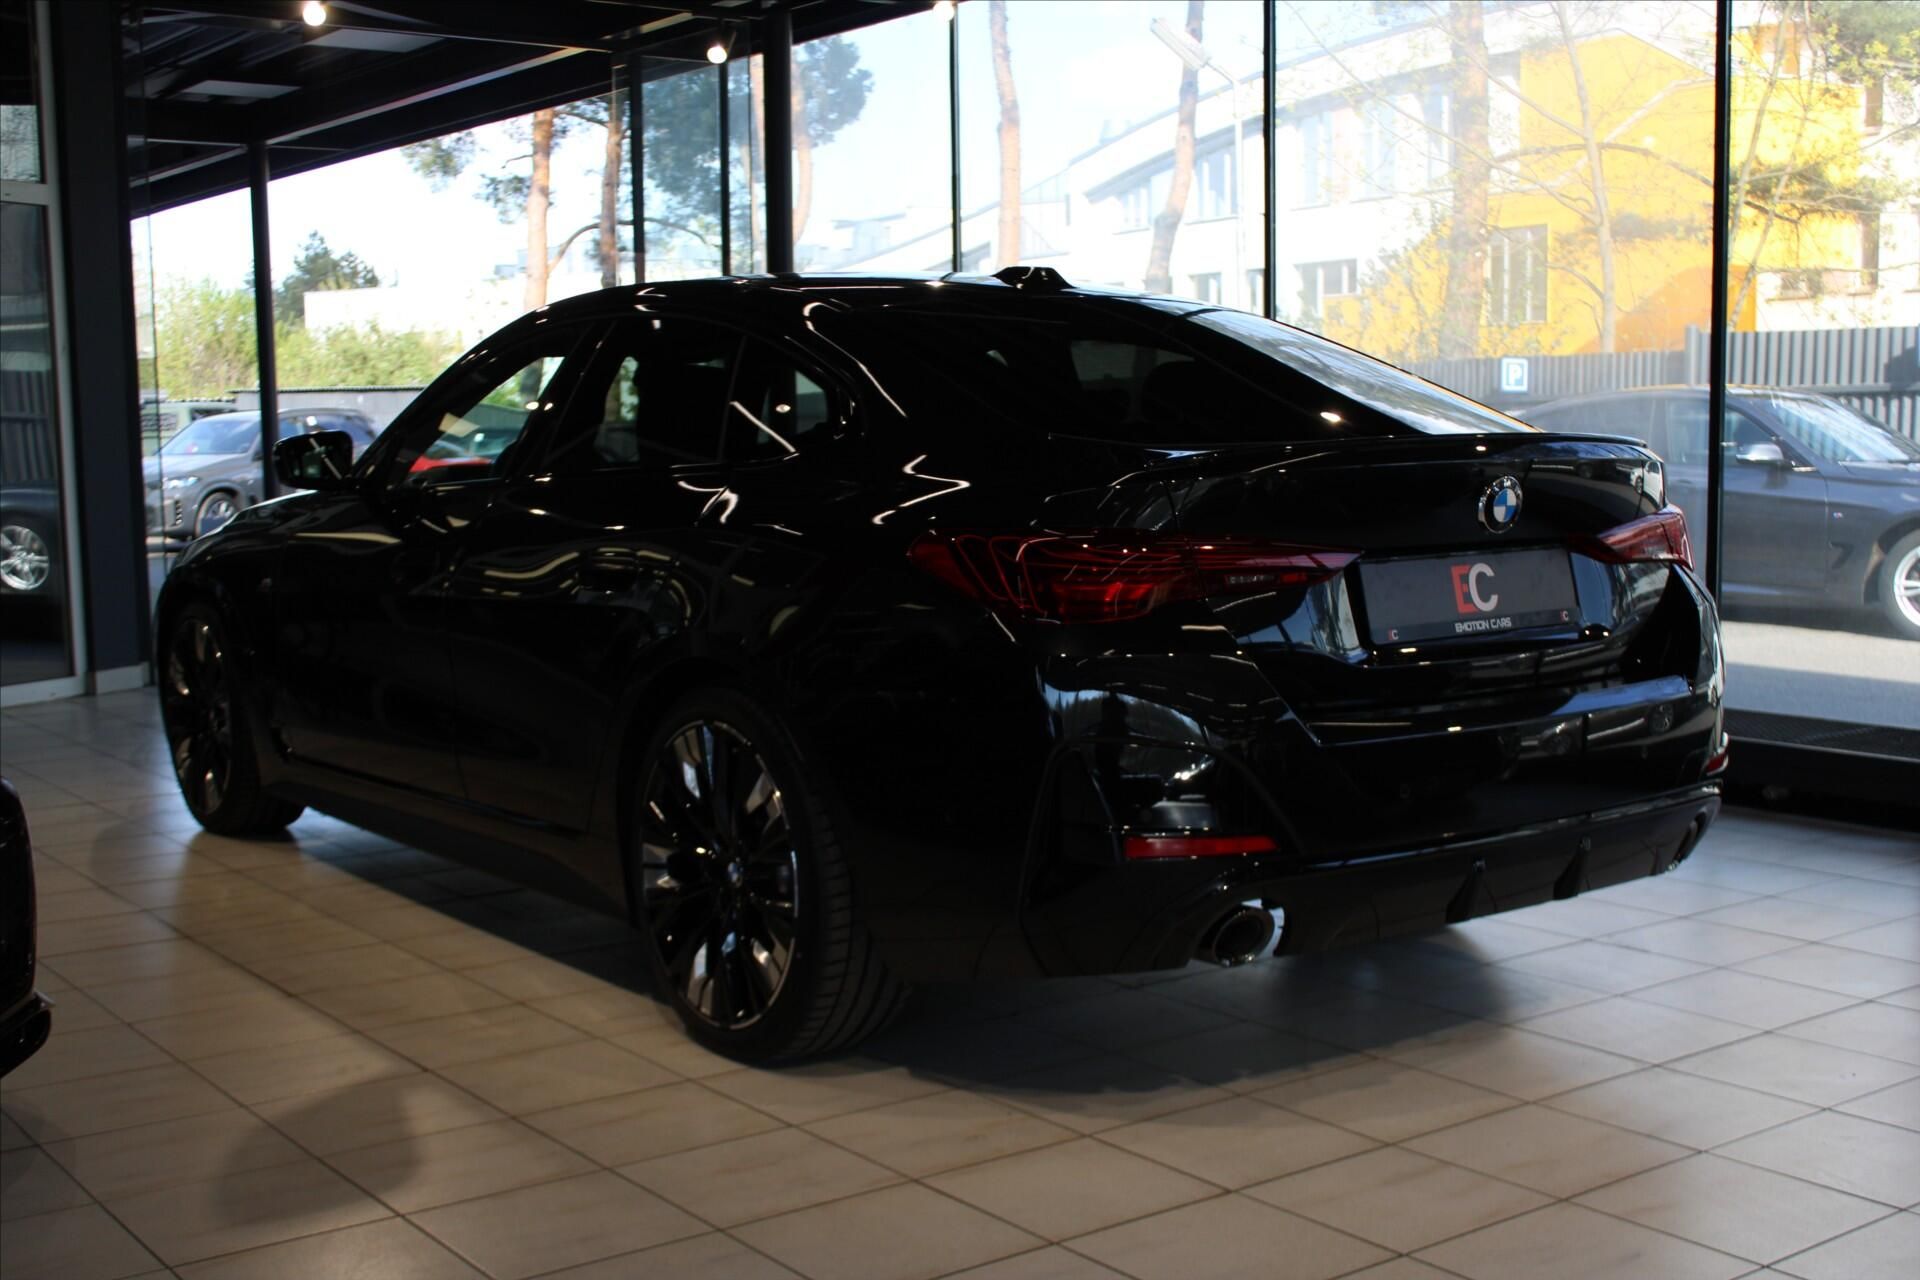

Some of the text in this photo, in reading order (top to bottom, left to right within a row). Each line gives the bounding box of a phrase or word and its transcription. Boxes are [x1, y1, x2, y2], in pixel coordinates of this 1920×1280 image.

[1508, 364, 1523, 385] P
[1451, 562, 1499, 614] EC
[1454, 616, 1512, 633] EMOTION CARS
